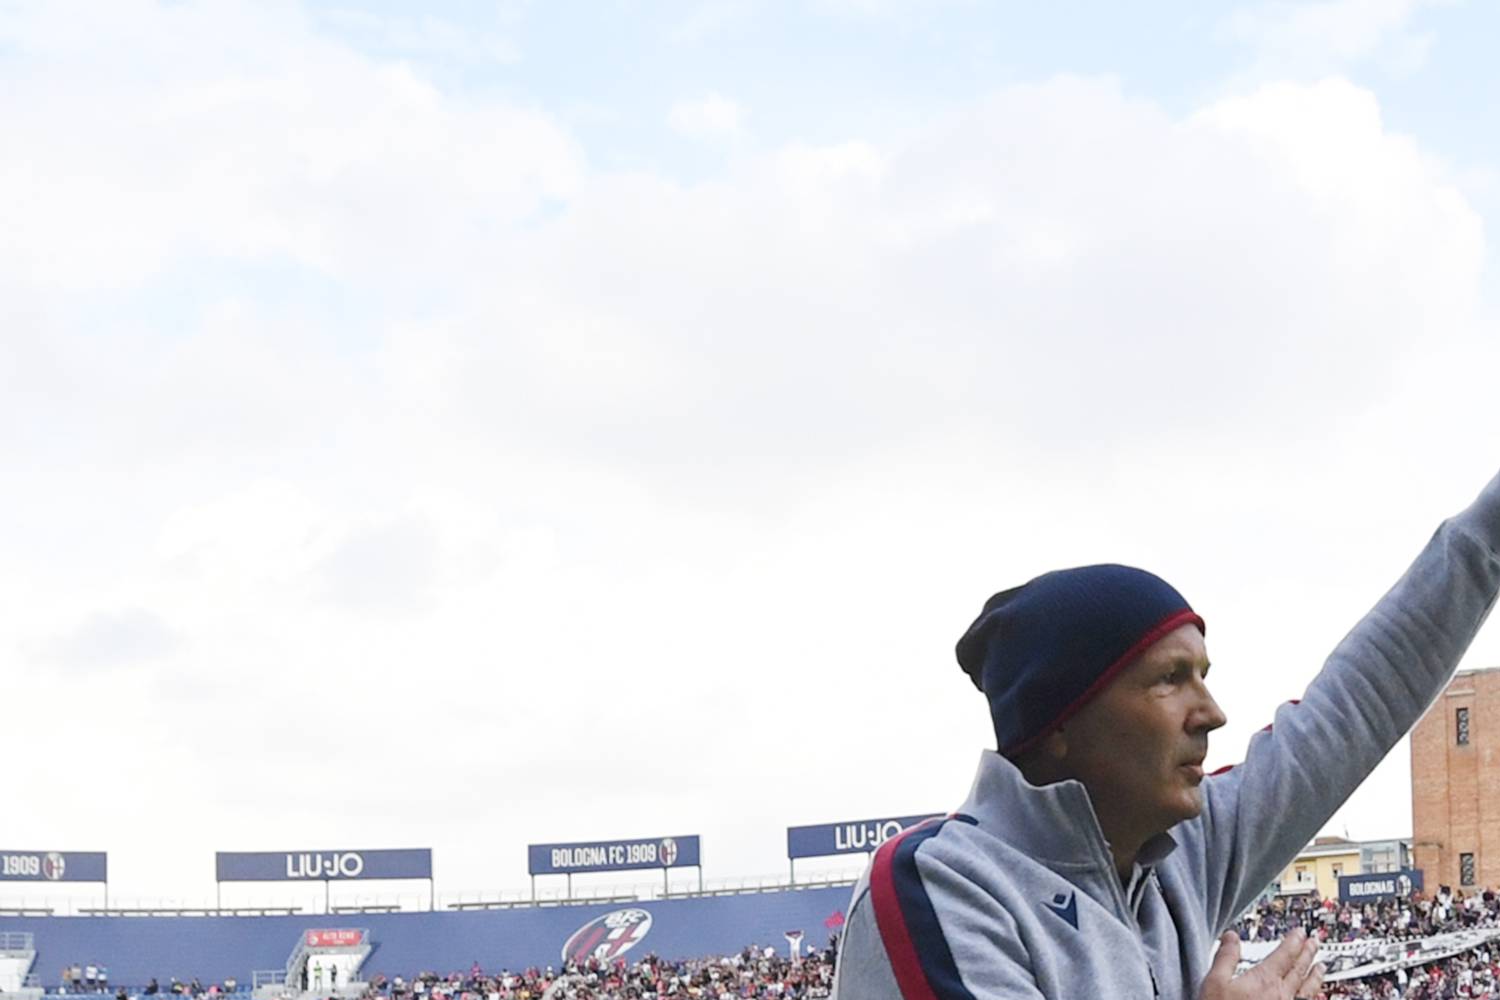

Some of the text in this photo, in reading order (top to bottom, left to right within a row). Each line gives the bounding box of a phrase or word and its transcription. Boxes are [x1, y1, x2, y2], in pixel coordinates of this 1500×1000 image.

[2, 855, 40, 875] 1909
[552, 843, 657, 868] BOLOGNA FC 1909
